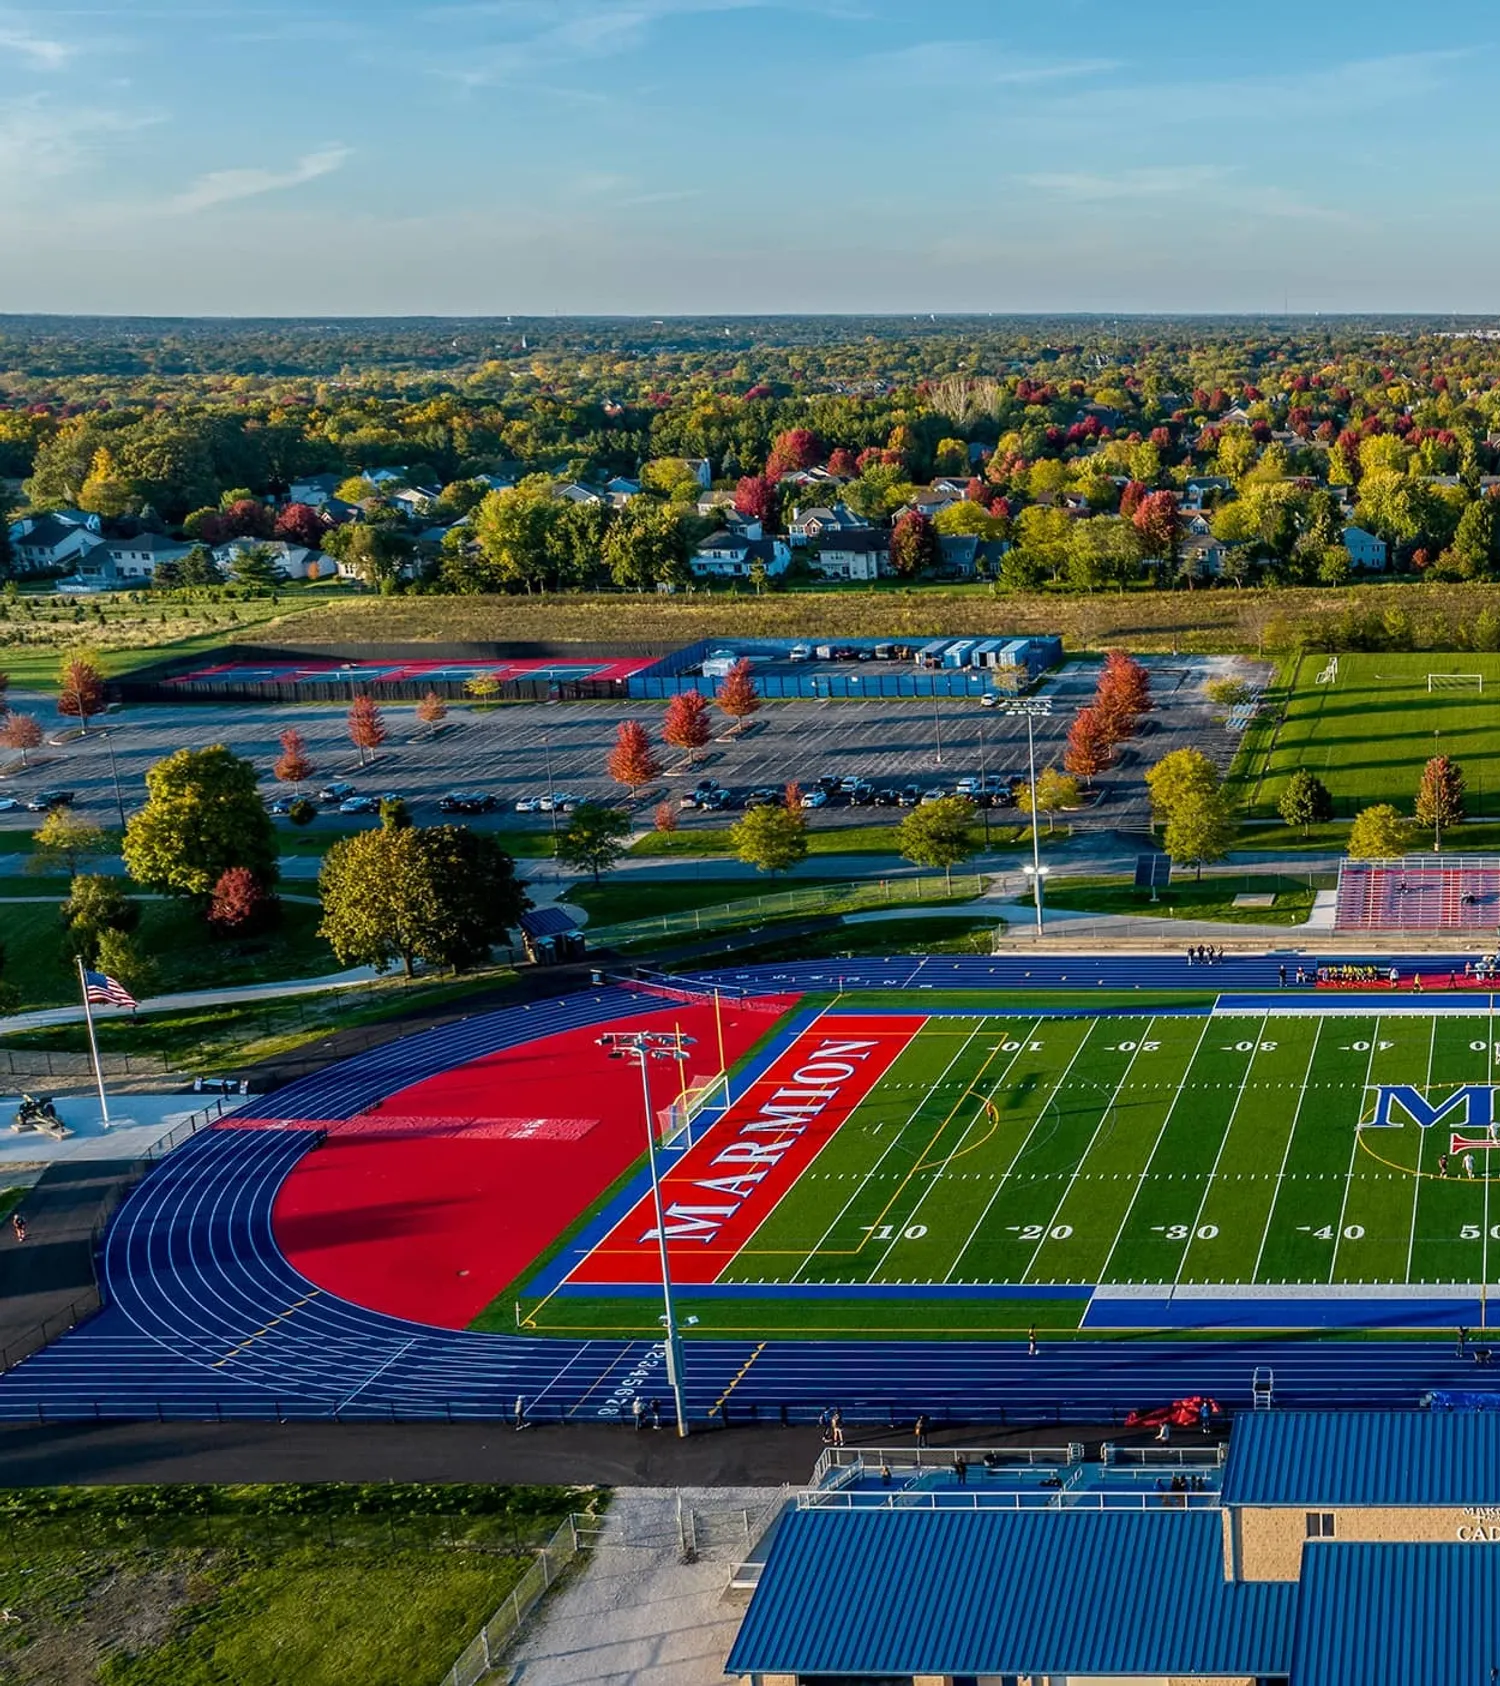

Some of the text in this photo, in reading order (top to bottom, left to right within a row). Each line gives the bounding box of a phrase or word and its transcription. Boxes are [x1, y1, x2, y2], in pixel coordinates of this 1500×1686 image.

[1001, 1041, 1045, 1051] 10
[1118, 1041, 1162, 1051] 20
[1235, 1040, 1278, 1051] 30
[1352, 1040, 1395, 1051] 40
[638, 1039, 880, 1243] MARMION
[872, 1225, 929, 1240] 10
[1018, 1225, 1074, 1240] 20
[1165, 1225, 1220, 1240] 30
[1313, 1225, 1365, 1240] 40
